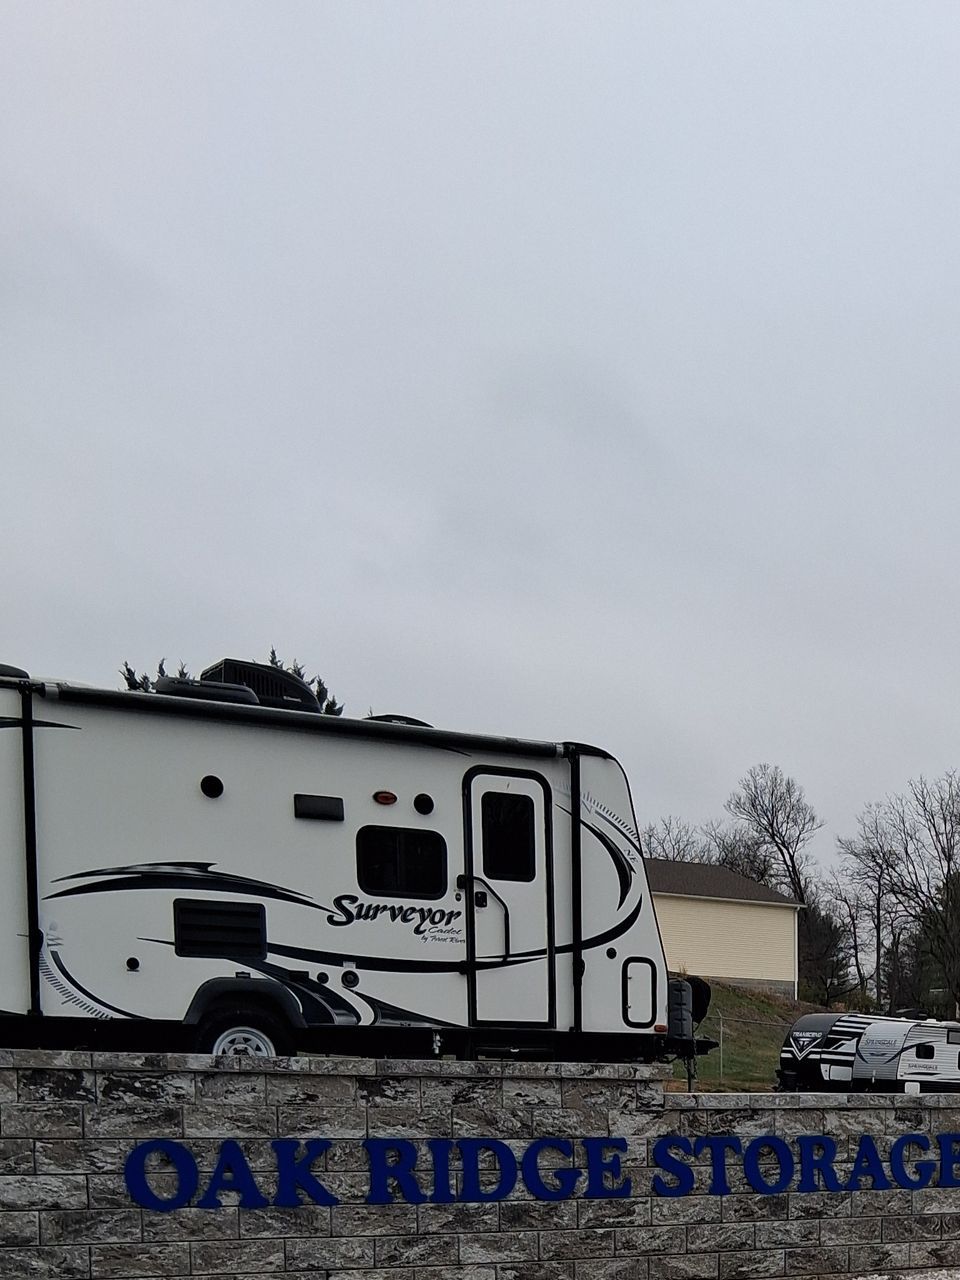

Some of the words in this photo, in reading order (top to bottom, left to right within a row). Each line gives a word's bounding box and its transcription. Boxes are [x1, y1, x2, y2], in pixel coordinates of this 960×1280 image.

[326, 894, 462, 935] Surveyor
[124, 1138, 340, 1212] OAK
[362, 1136, 633, 1205] RIDGE
